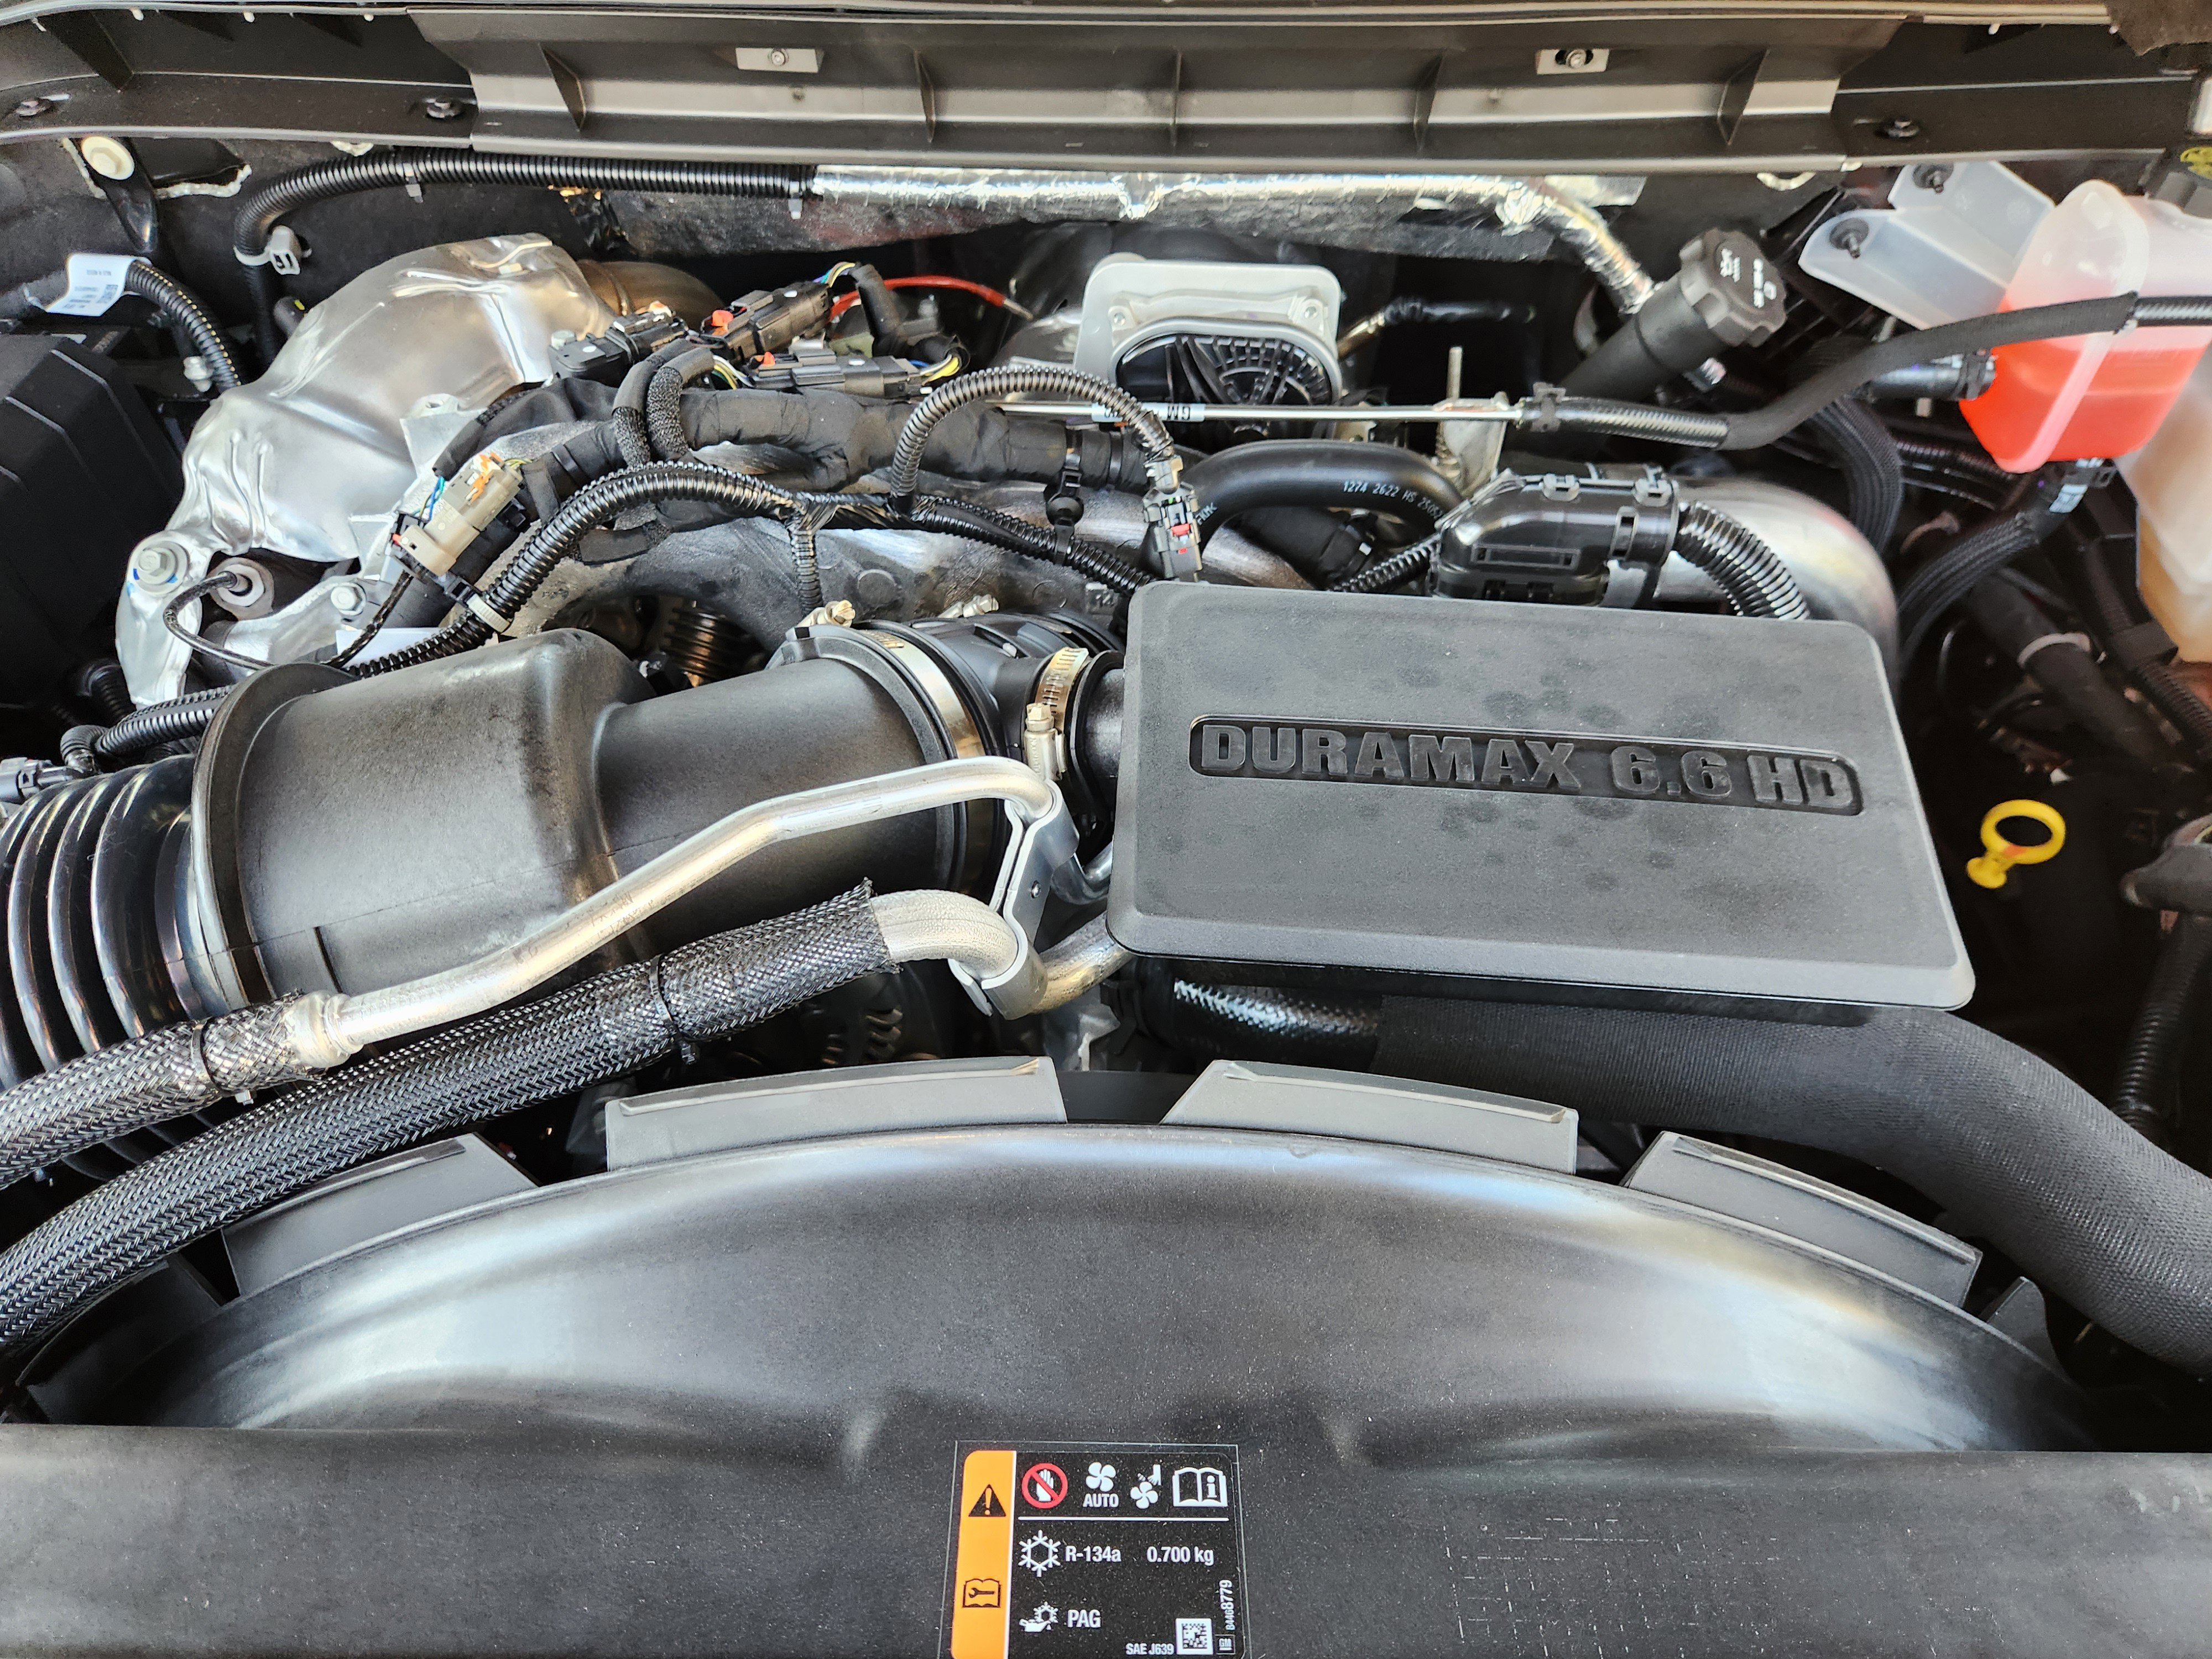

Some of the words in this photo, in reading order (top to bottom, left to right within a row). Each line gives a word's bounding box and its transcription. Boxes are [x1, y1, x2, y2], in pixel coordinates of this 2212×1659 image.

[1167, 404, 1190, 420] GM
[1343, 480, 1369, 493] 1274
[1372, 483, 1401, 497] 2622
[1202, 724, 1581, 788] DURAMAX
[1611, 746, 1732, 798] 6.6
[1747, 754, 1853, 808] HD
[1083, 1493, 1119, 1507] AUTO
[1065, 1546, 1121, 1562] R-134a
[1146, 1546, 1191, 1563] 0.700
[1194, 1546, 1214, 1566] kg
[1067, 1609, 1101, 1627] PAG
[1125, 1643, 1147, 1655] SAE
[1148, 1643, 1175, 1655] J639
[1218, 1638, 1233, 1648] GM
